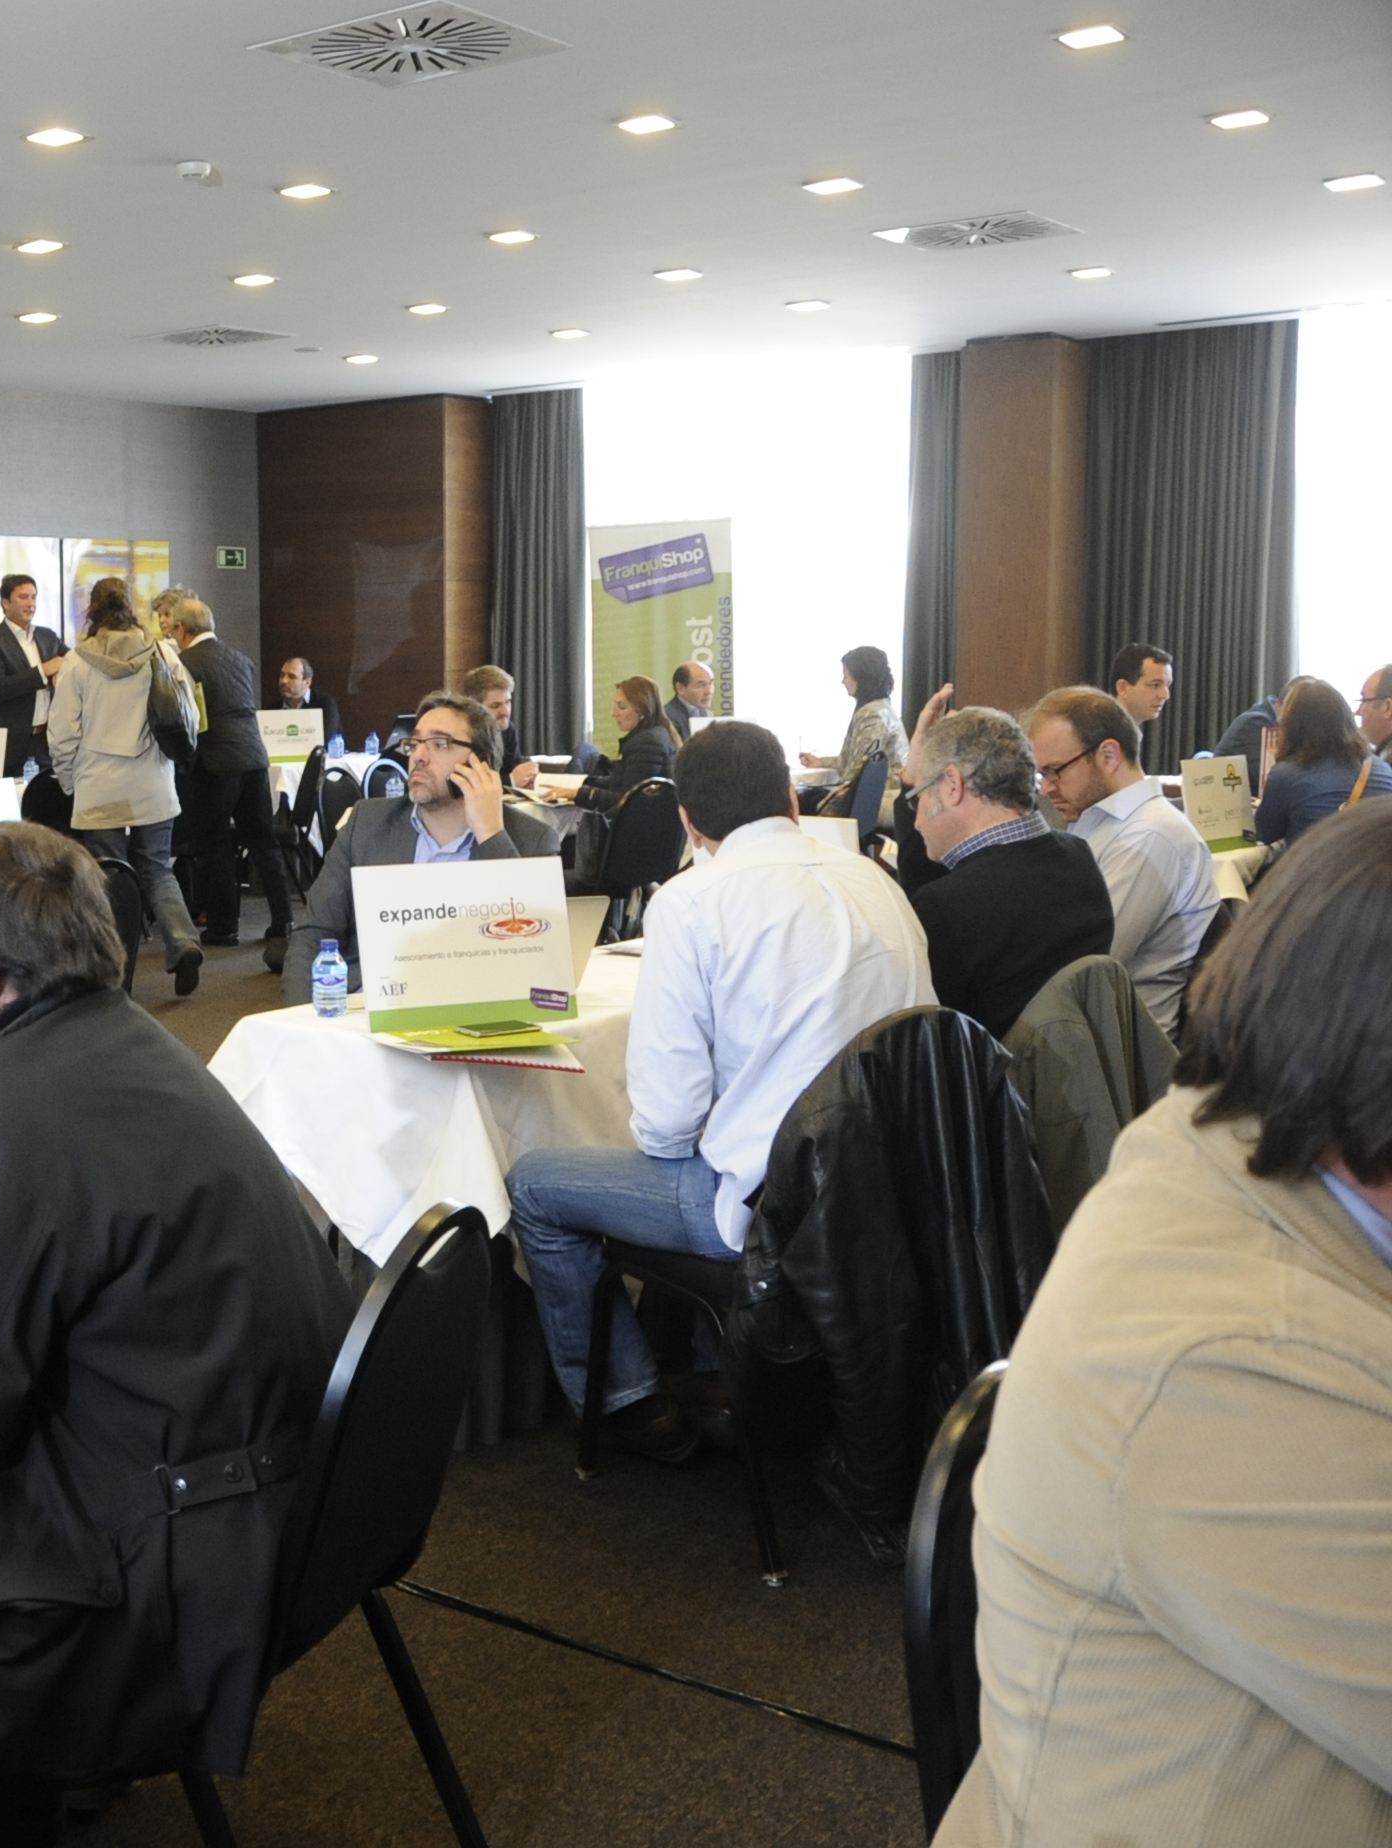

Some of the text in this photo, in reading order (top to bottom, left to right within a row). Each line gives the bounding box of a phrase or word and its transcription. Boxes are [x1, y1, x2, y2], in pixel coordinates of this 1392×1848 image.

[604, 547, 705, 583] FranquiShop
[685, 616, 713, 665] ost
[379, 897, 525, 925] expandenegocio
